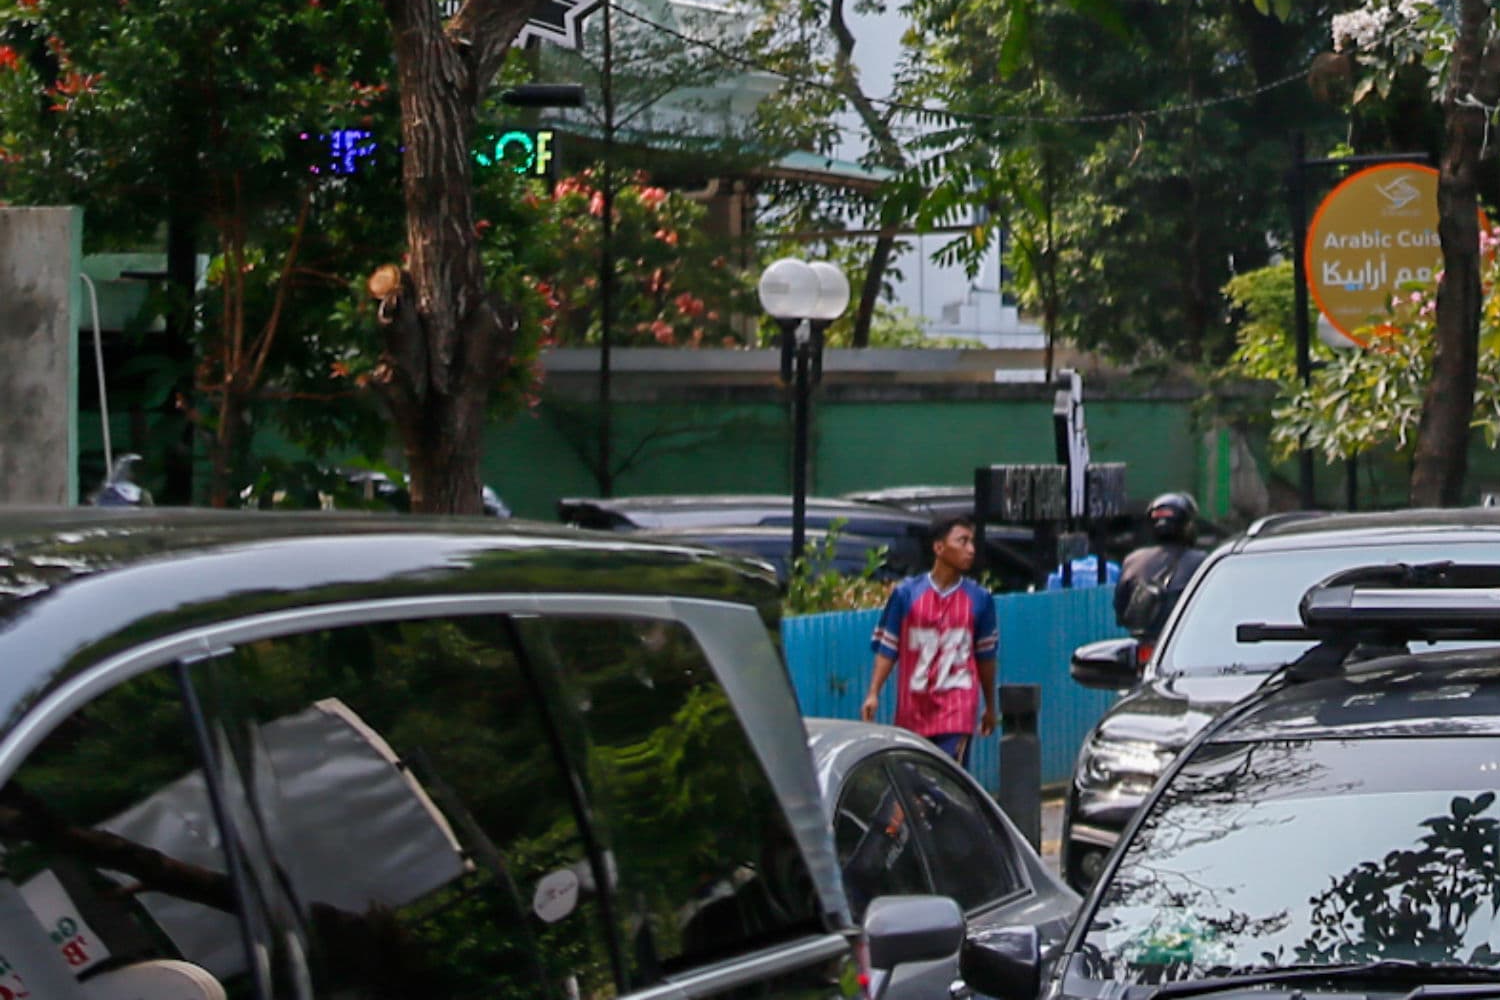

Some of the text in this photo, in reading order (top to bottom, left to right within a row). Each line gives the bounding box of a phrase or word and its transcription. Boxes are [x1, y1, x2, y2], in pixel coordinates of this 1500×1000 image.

[1323, 228, 1441, 249] Arabic Cuis
[908, 627, 973, 692] 72
